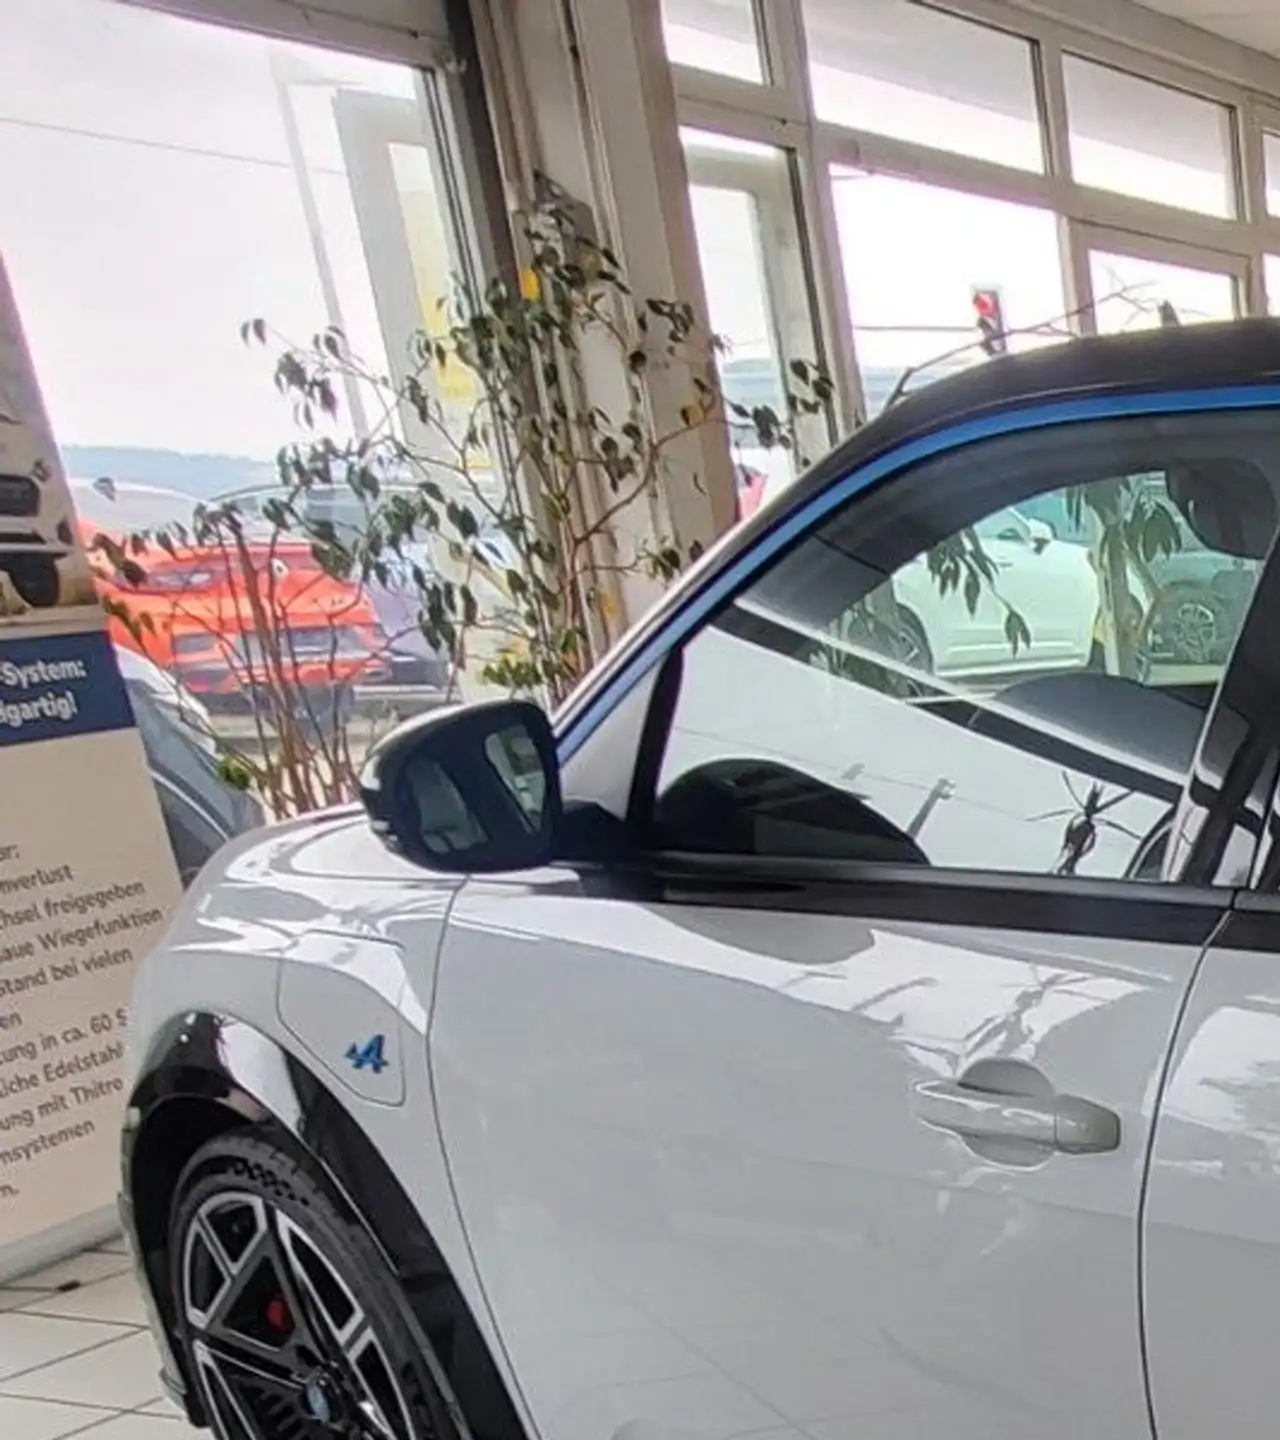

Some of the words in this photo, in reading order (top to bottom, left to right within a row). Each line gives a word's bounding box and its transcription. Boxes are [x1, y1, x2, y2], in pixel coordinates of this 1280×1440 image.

[36, 908, 164, 952] Wiegefunktion
[82, 947, 134, 973] vielen
[39, 1032, 60, 1051] in
[90, 1011, 113, 1034] 60
